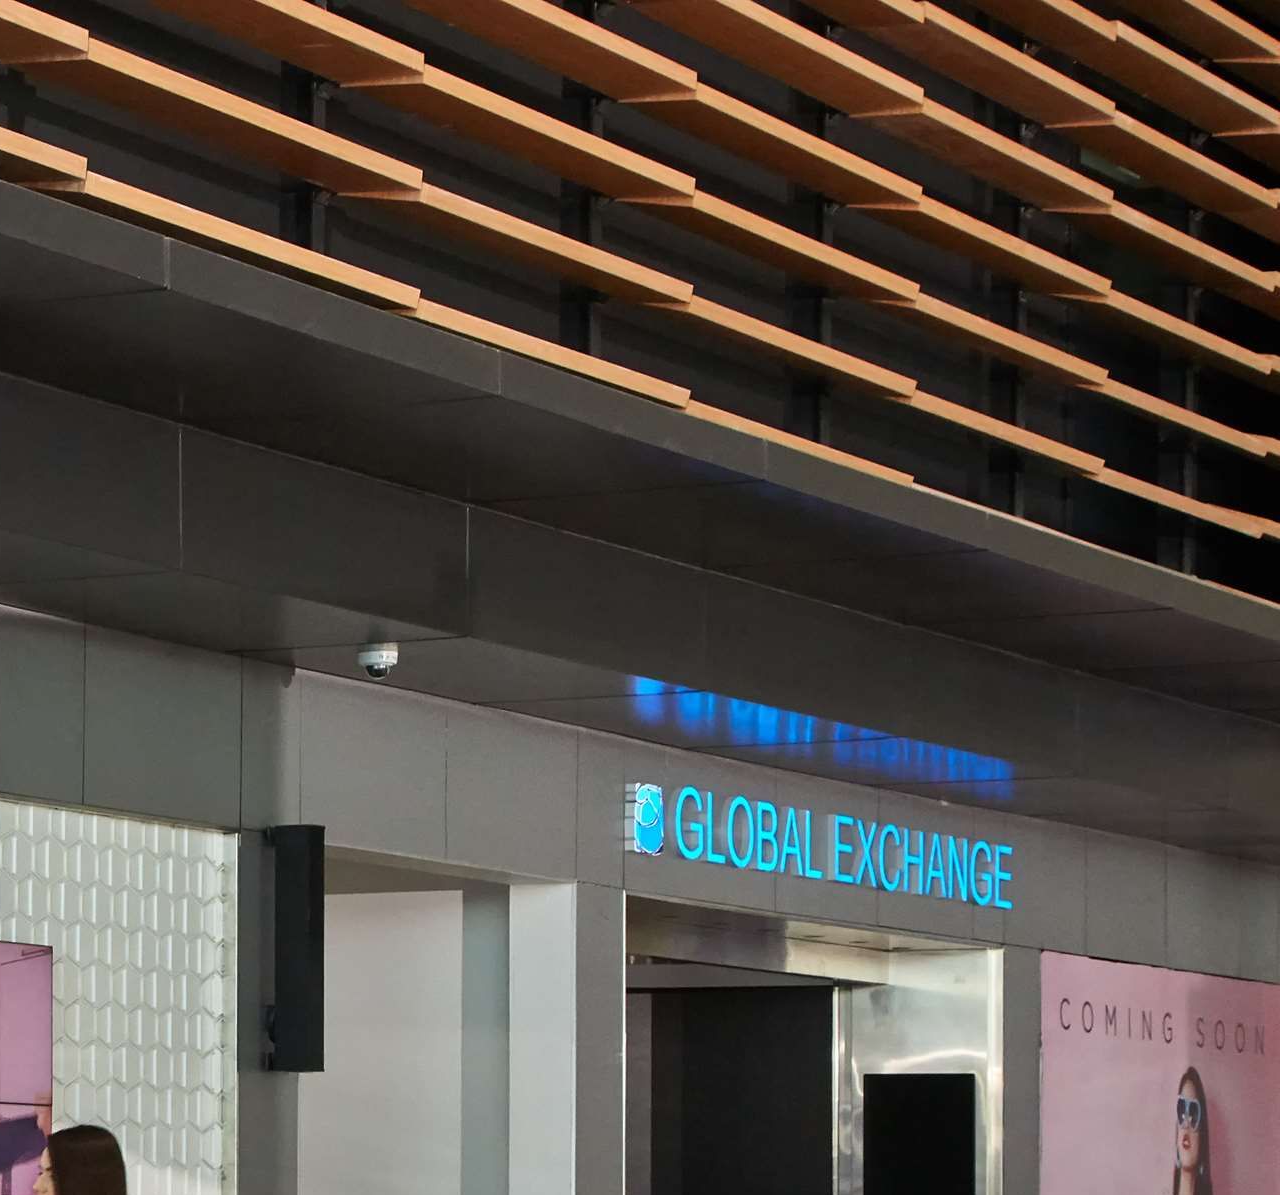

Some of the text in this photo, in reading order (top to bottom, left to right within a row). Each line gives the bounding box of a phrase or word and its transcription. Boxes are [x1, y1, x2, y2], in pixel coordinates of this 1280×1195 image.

[674, 784, 1014, 910] GLOBAL EXCHANGE
[1059, 998, 1266, 1055] COMING SOON
